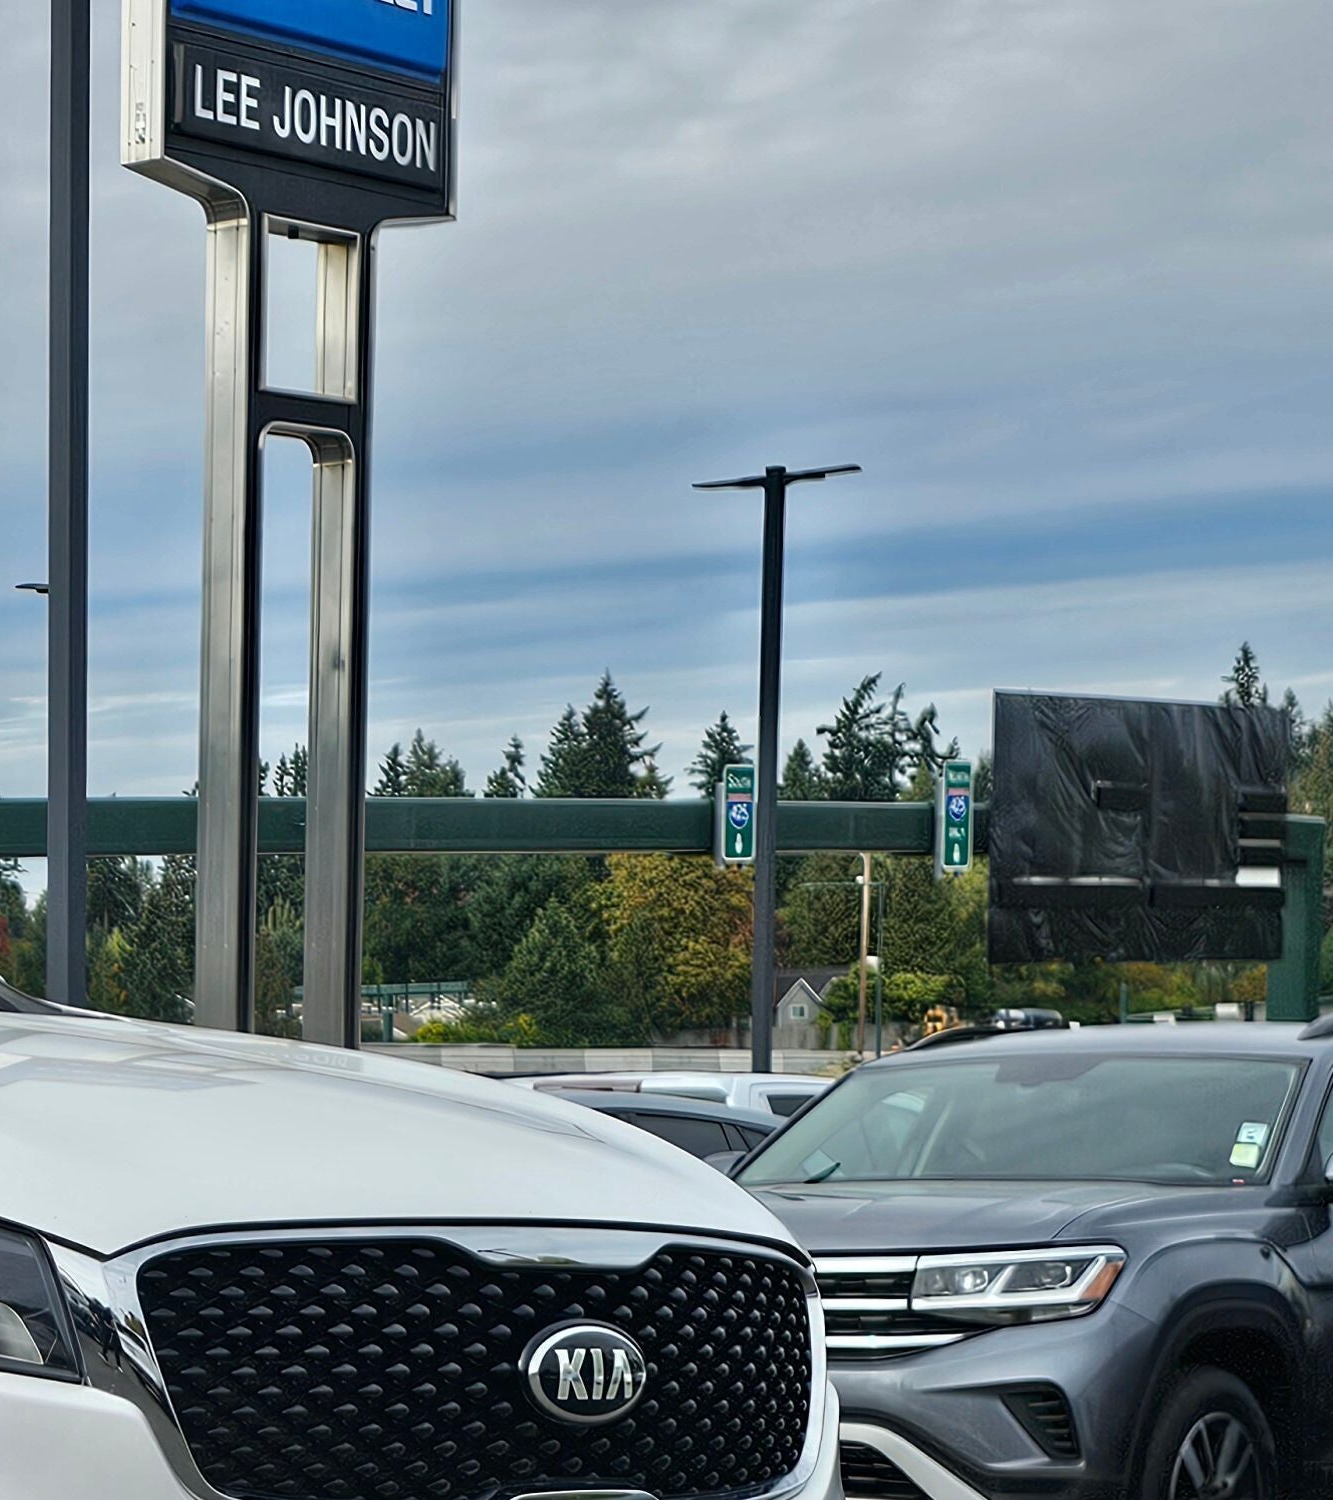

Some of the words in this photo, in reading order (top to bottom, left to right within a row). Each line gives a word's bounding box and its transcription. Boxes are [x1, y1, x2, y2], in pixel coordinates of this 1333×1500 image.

[194, 64, 261, 131] LEE
[272, 85, 436, 172] JOHNSON
[554, 1348, 633, 1400] KIA
